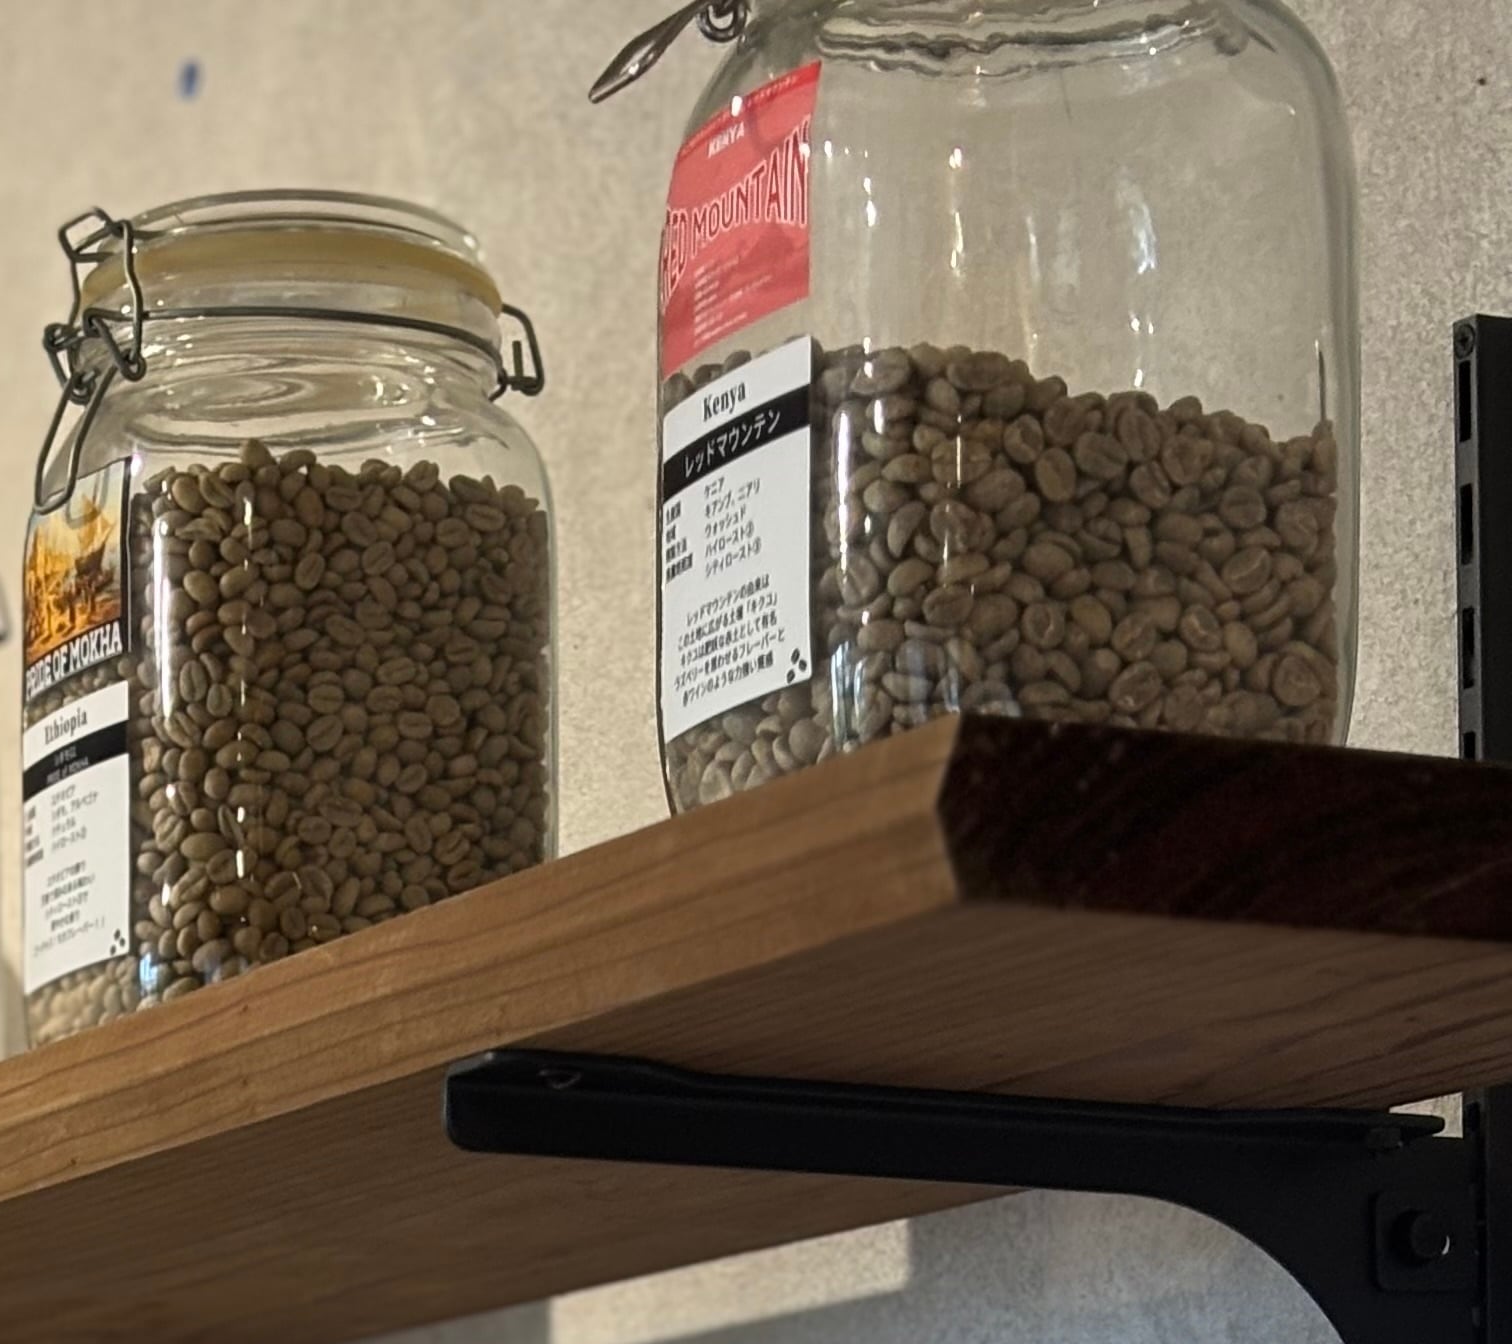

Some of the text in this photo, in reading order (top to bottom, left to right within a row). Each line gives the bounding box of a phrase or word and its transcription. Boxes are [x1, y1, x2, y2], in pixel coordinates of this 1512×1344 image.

[708, 122, 745, 159] KENYA
[691, 114, 810, 260] MOUNTAIN
[702, 382, 746, 422] Kenya
[684, 408, 781, 478] レッドマウンテン
[704, 477, 725, 498] ケニア
[69, 620, 123, 672] MOKHA
[44, 706, 88, 745] Ethiopia
